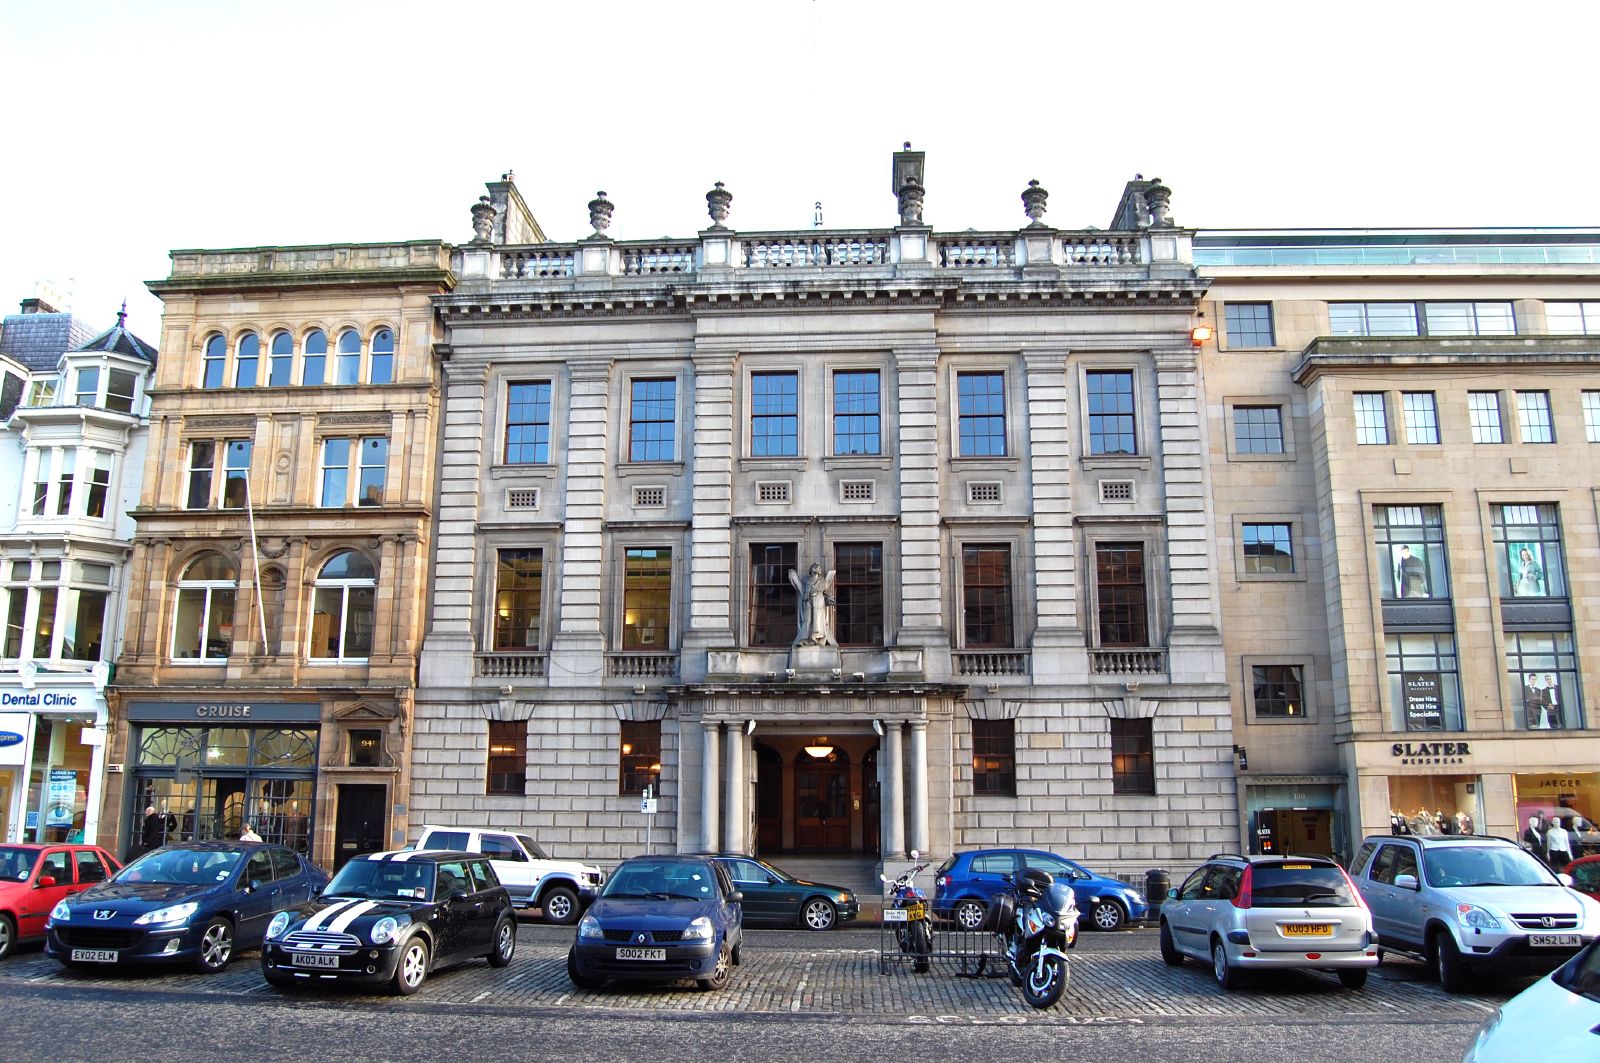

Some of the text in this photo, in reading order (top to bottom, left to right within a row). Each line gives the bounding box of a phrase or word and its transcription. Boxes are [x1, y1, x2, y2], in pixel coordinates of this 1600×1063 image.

[2, 693, 77, 706] Dental Clinic
[196, 705, 251, 717] CRUISE
[0, 734, 18, 742] press
[1392, 743, 1472, 756] SLATER
[1539, 779, 1581, 788] JAEGER
[1286, 924, 1328, 933] KU03 HFD
[1559, 936, 1577, 945] LJN
[74, 950, 115, 961] EV02 ELM
[644, 950, 662, 959] FKT
[295, 955, 335, 966] AK03 ALK
